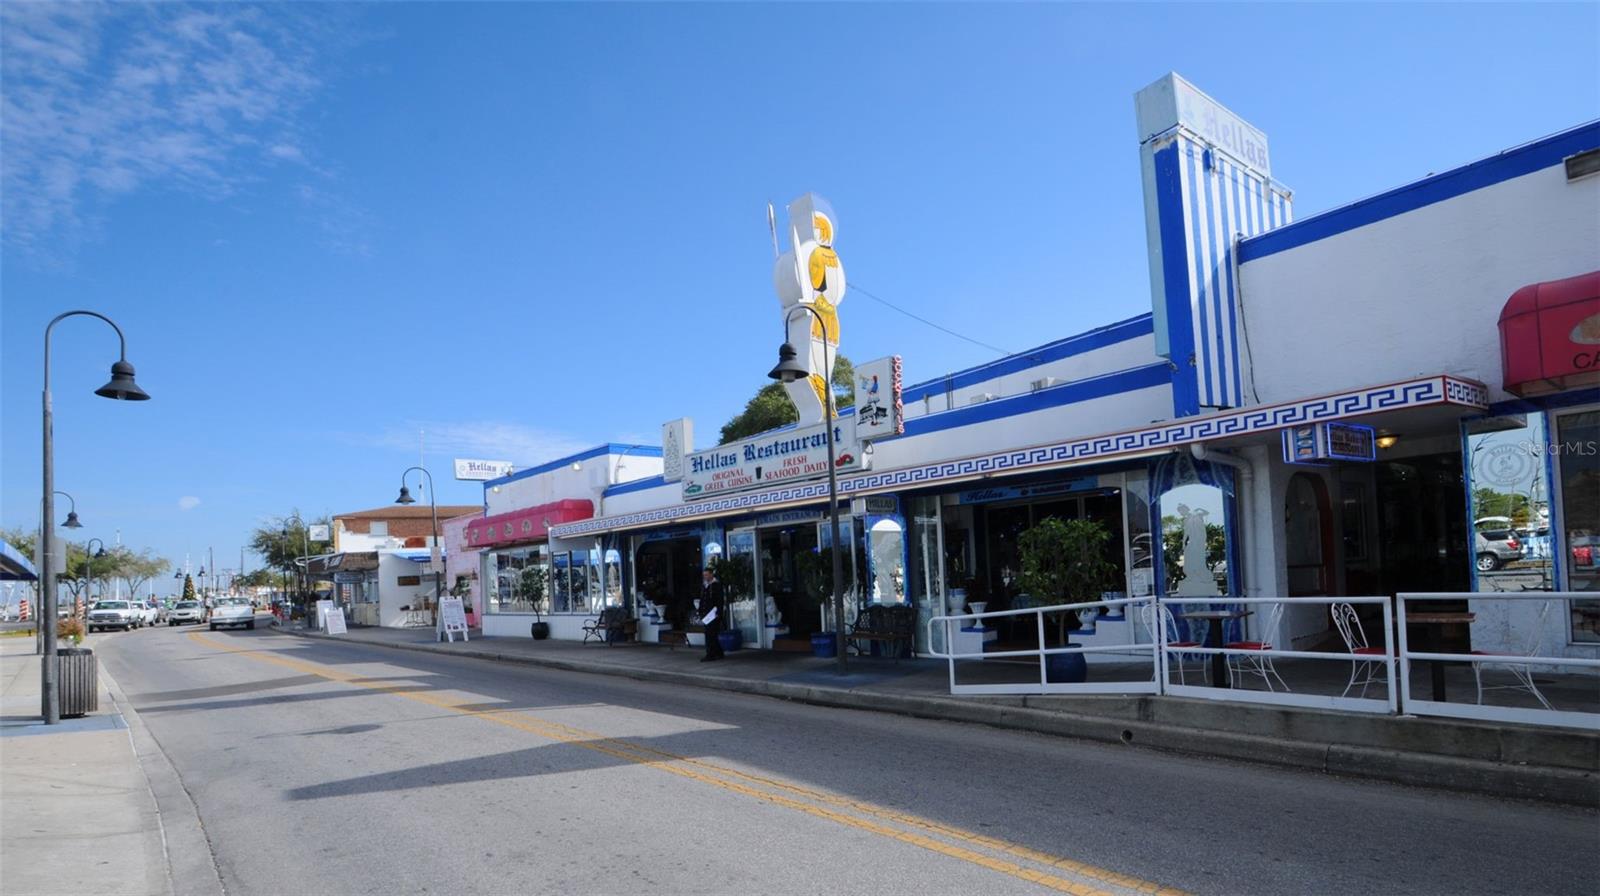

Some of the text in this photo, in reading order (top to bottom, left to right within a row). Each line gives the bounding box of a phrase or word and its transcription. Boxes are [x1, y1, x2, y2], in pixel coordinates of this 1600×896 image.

[1203, 107, 1268, 169] Hellas
[467, 462, 497, 473] Hellas
[691, 452, 737, 474] Hellas
[783, 455, 808, 468] FRESH
[712, 468, 744, 482] ORIGINAL
[764, 460, 829, 481] SEAFOOD DAILY
[704, 475, 754, 492] GREEK CUISINE
